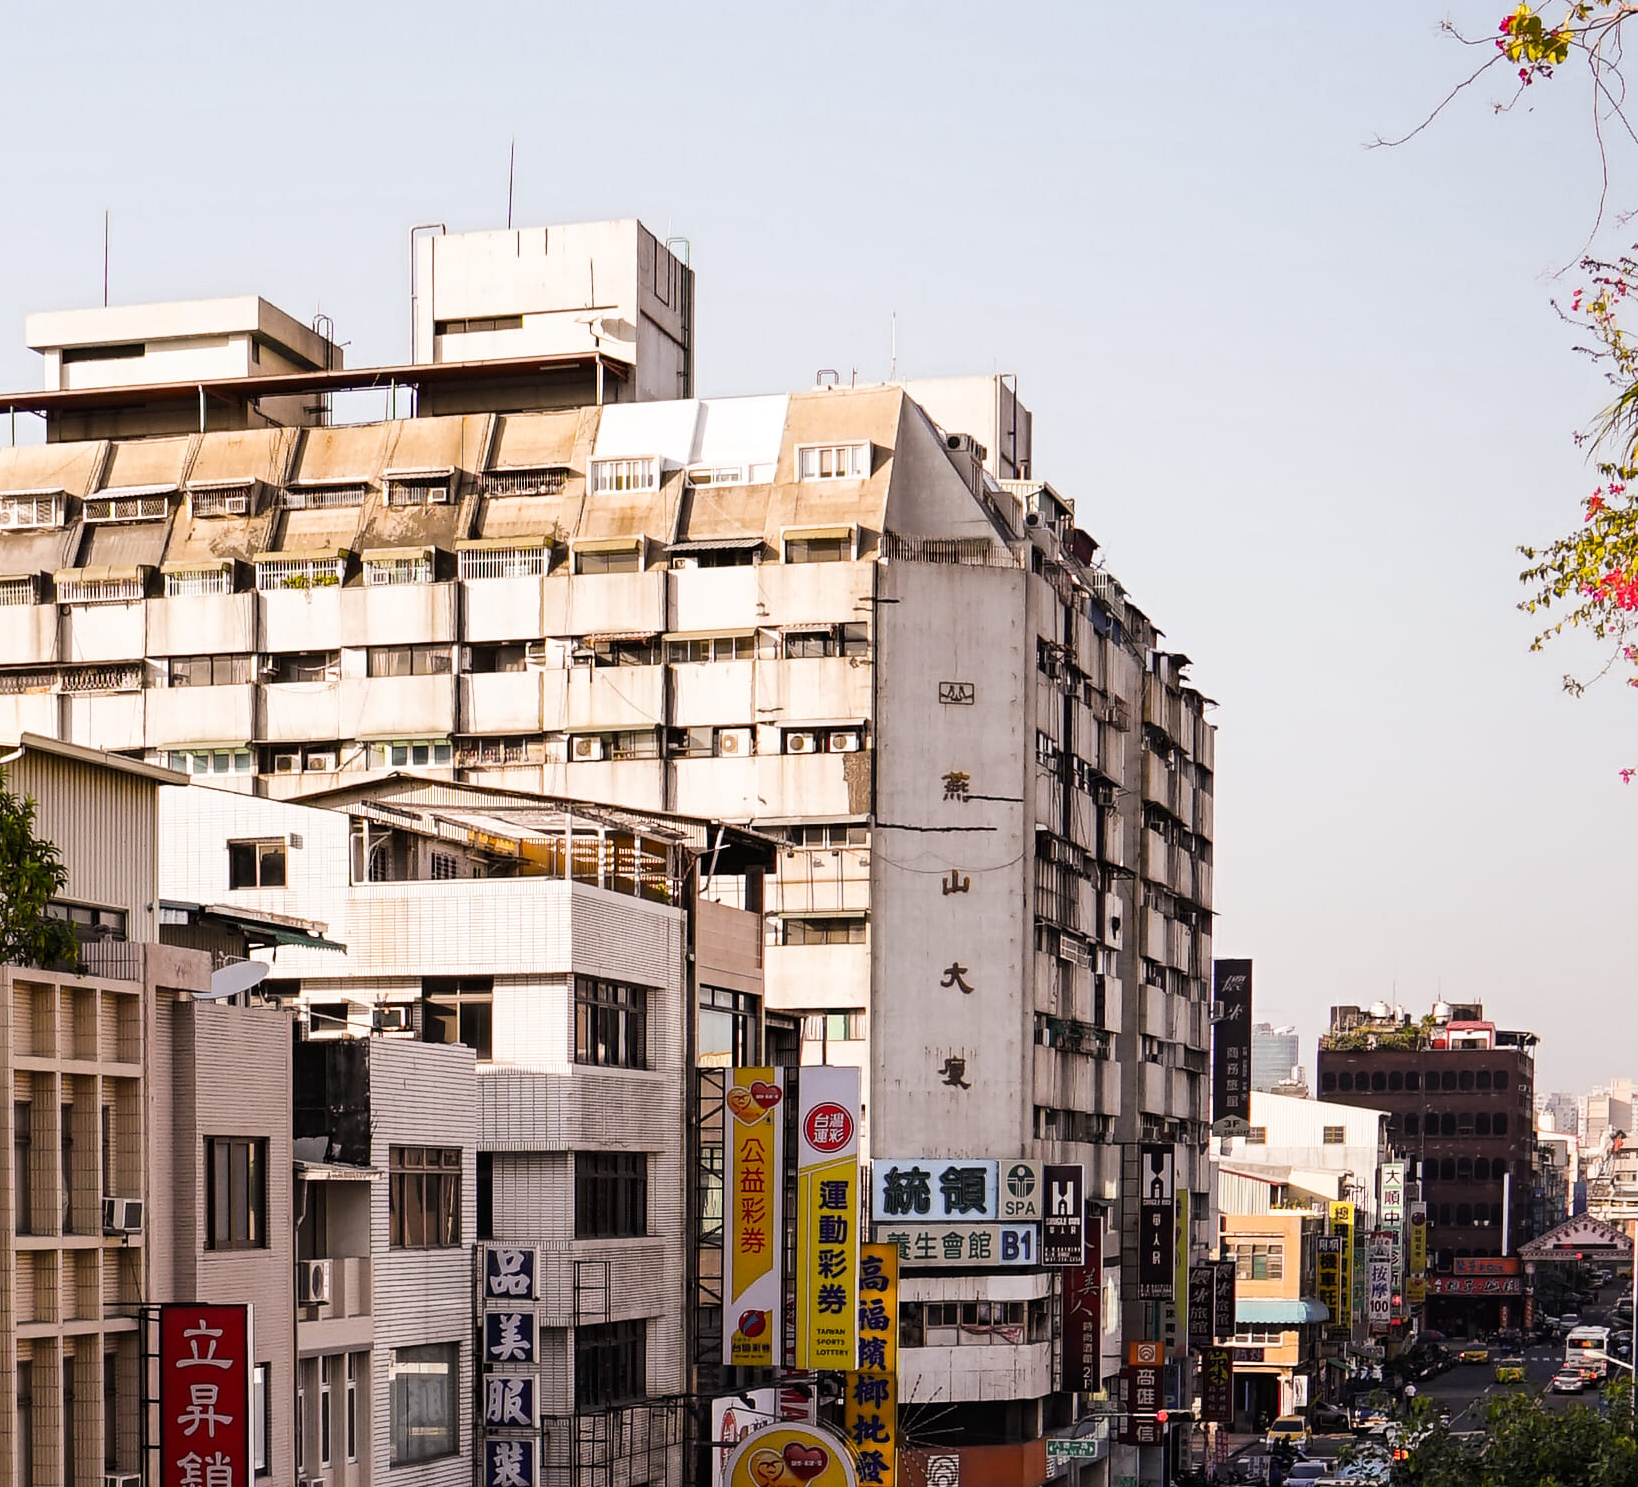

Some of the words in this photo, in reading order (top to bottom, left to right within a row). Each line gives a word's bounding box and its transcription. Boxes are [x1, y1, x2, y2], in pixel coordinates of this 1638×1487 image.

[740, 1137, 766, 1255] 公益彩券
[883, 1166, 987, 1215] 統領
[1005, 1200, 1036, 1216] SPA
[818, 1180, 850, 1315] 運動彩券
[886, 1231, 992, 1260] 養生會館
[1002, 1230, 1032, 1261] B1
[1369, 1300, 1389, 1313] 100
